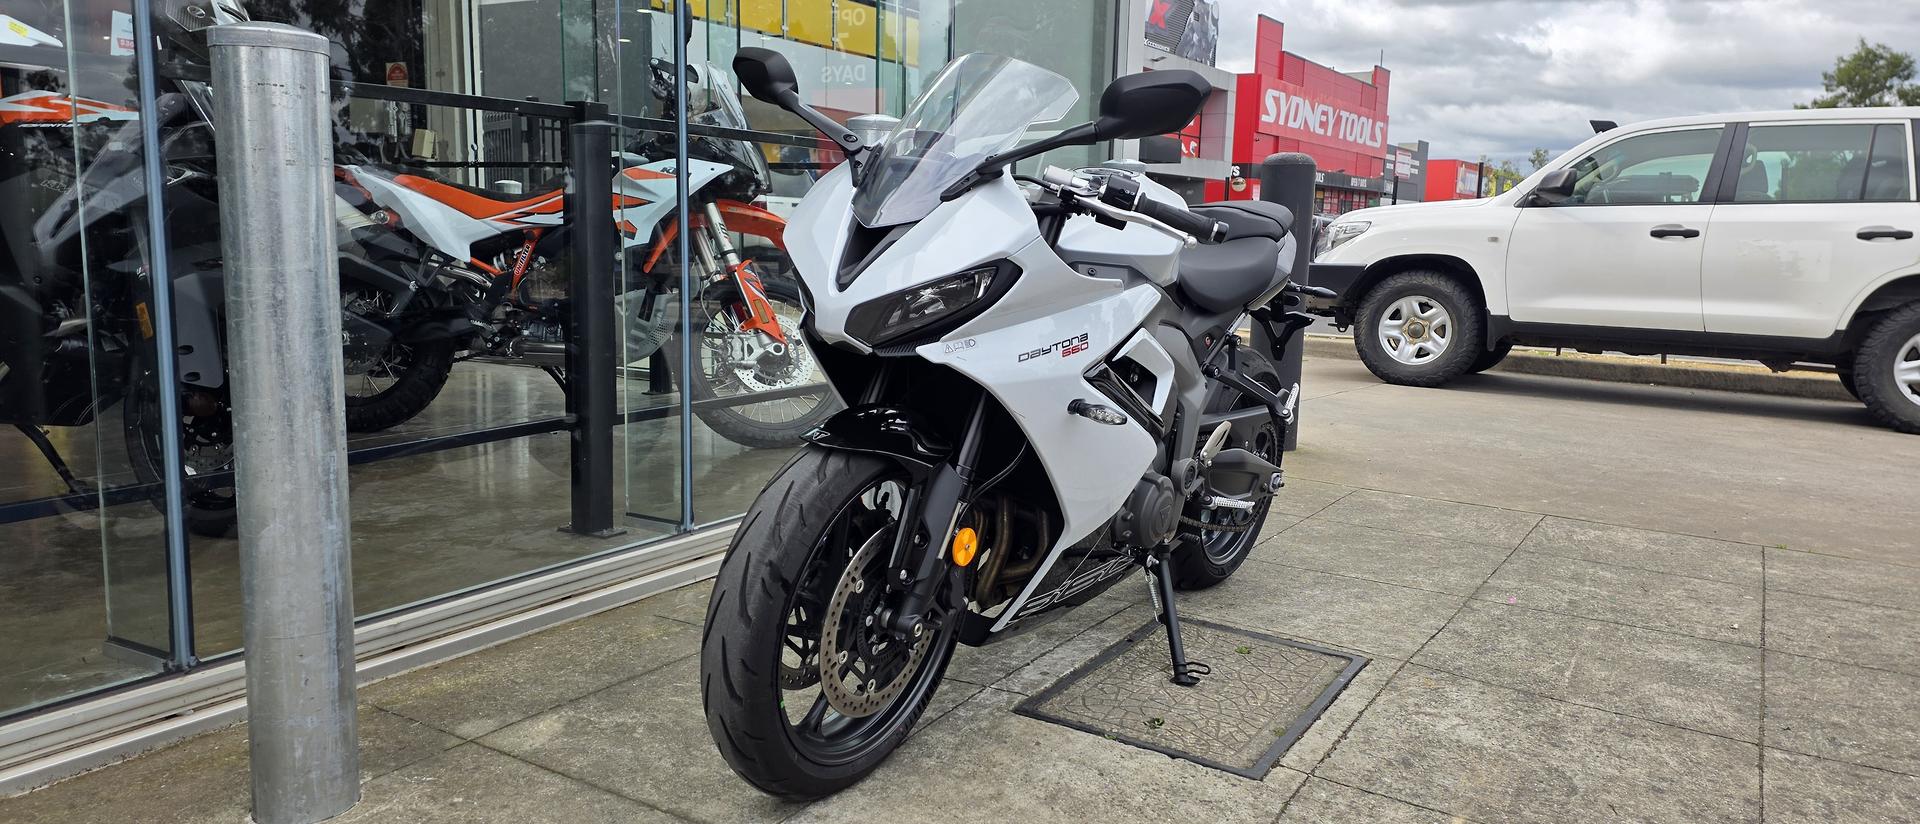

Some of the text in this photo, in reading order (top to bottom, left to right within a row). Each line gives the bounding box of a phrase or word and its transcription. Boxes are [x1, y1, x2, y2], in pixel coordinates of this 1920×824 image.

[1261, 88, 1384, 148] SYDNEY TOOLS
[514, 243, 531, 275] UNIFILTER
[1018, 332, 1088, 362] DAYTONA
[1062, 341, 1089, 358] 660
